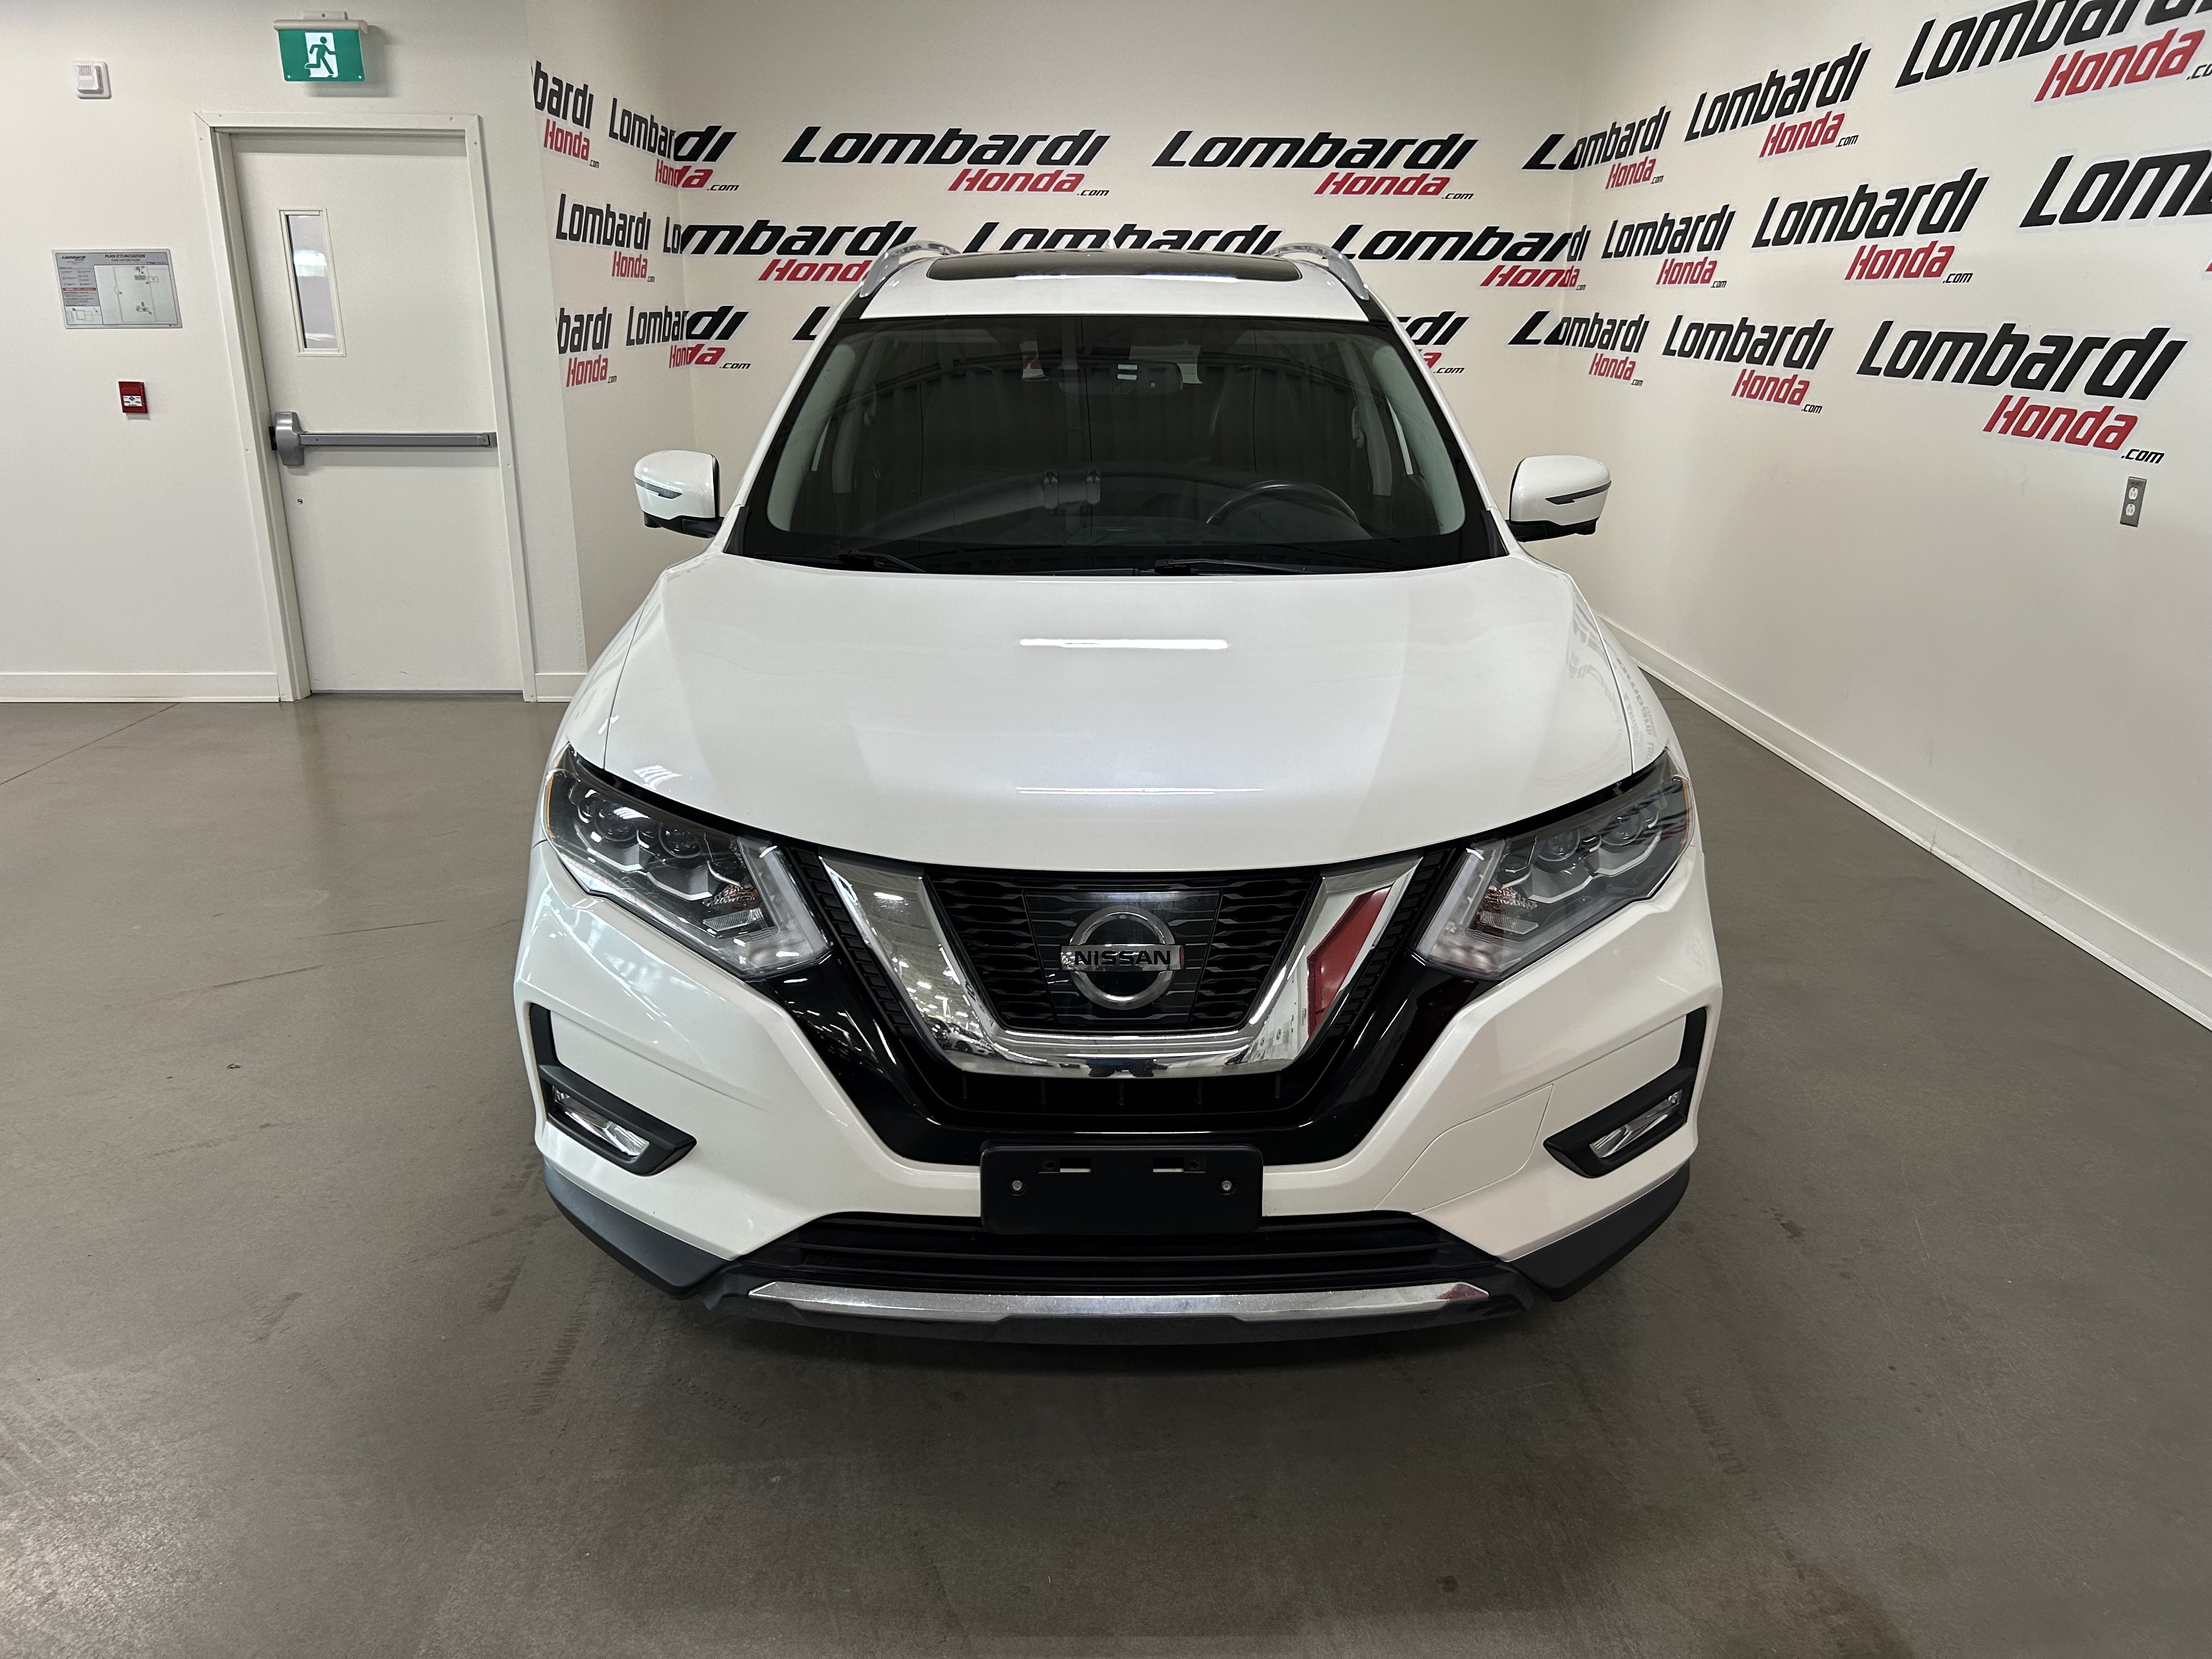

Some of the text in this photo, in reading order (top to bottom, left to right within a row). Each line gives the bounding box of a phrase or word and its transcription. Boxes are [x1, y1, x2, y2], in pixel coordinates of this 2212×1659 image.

[2034, 29, 2212, 102] Honda .co
[533, 60, 594, 129] bardi
[1684, 42, 1871, 142] Lombardi
[544, 119, 590, 160] Honda
[609, 98, 737, 162] Lombardi
[781, 127, 1110, 166] Lombardi
[1152, 131, 1479, 169] Lombardi
[1522, 105, 1671, 170] Lombardi
[1759, 111, 1859, 157] Honda .com
[656, 159, 713, 188] Honda
[948, 168, 1085, 193] Honda
[1314, 172, 1451, 196] Honda
[1606, 157, 1664, 188] Honda .com
[556, 194, 651, 250] Lombardi
[1752, 168, 1989, 248] Lombardi
[1322, 224, 1591, 262] Lombardi
[1601, 204, 1736, 258] Lombardi
[612, 252, 647, 278] Honda
[759, 258, 872, 281] Hond
[1481, 264, 1580, 287] Honda
[1656, 256, 1717, 285] Honda
[1845, 240, 1973, 283] Honda .com
[557, 307, 612, 354] bardi
[626, 306, 749, 346] Lombardi
[1508, 311, 1650, 353] Lombardi
[1662, 315, 1834, 370] Lombardi
[567, 356, 608, 386] Honda
[669, 343, 726, 367] Honda
[1589, 353, 1636, 380] Honda
[1856, 321, 2188, 400] Lombardi
[1731, 369, 1822, 414] Honda .com
[1984, 395, 2164, 464] Honda .com
[1075, 950, 1171, 966] NISSAN
